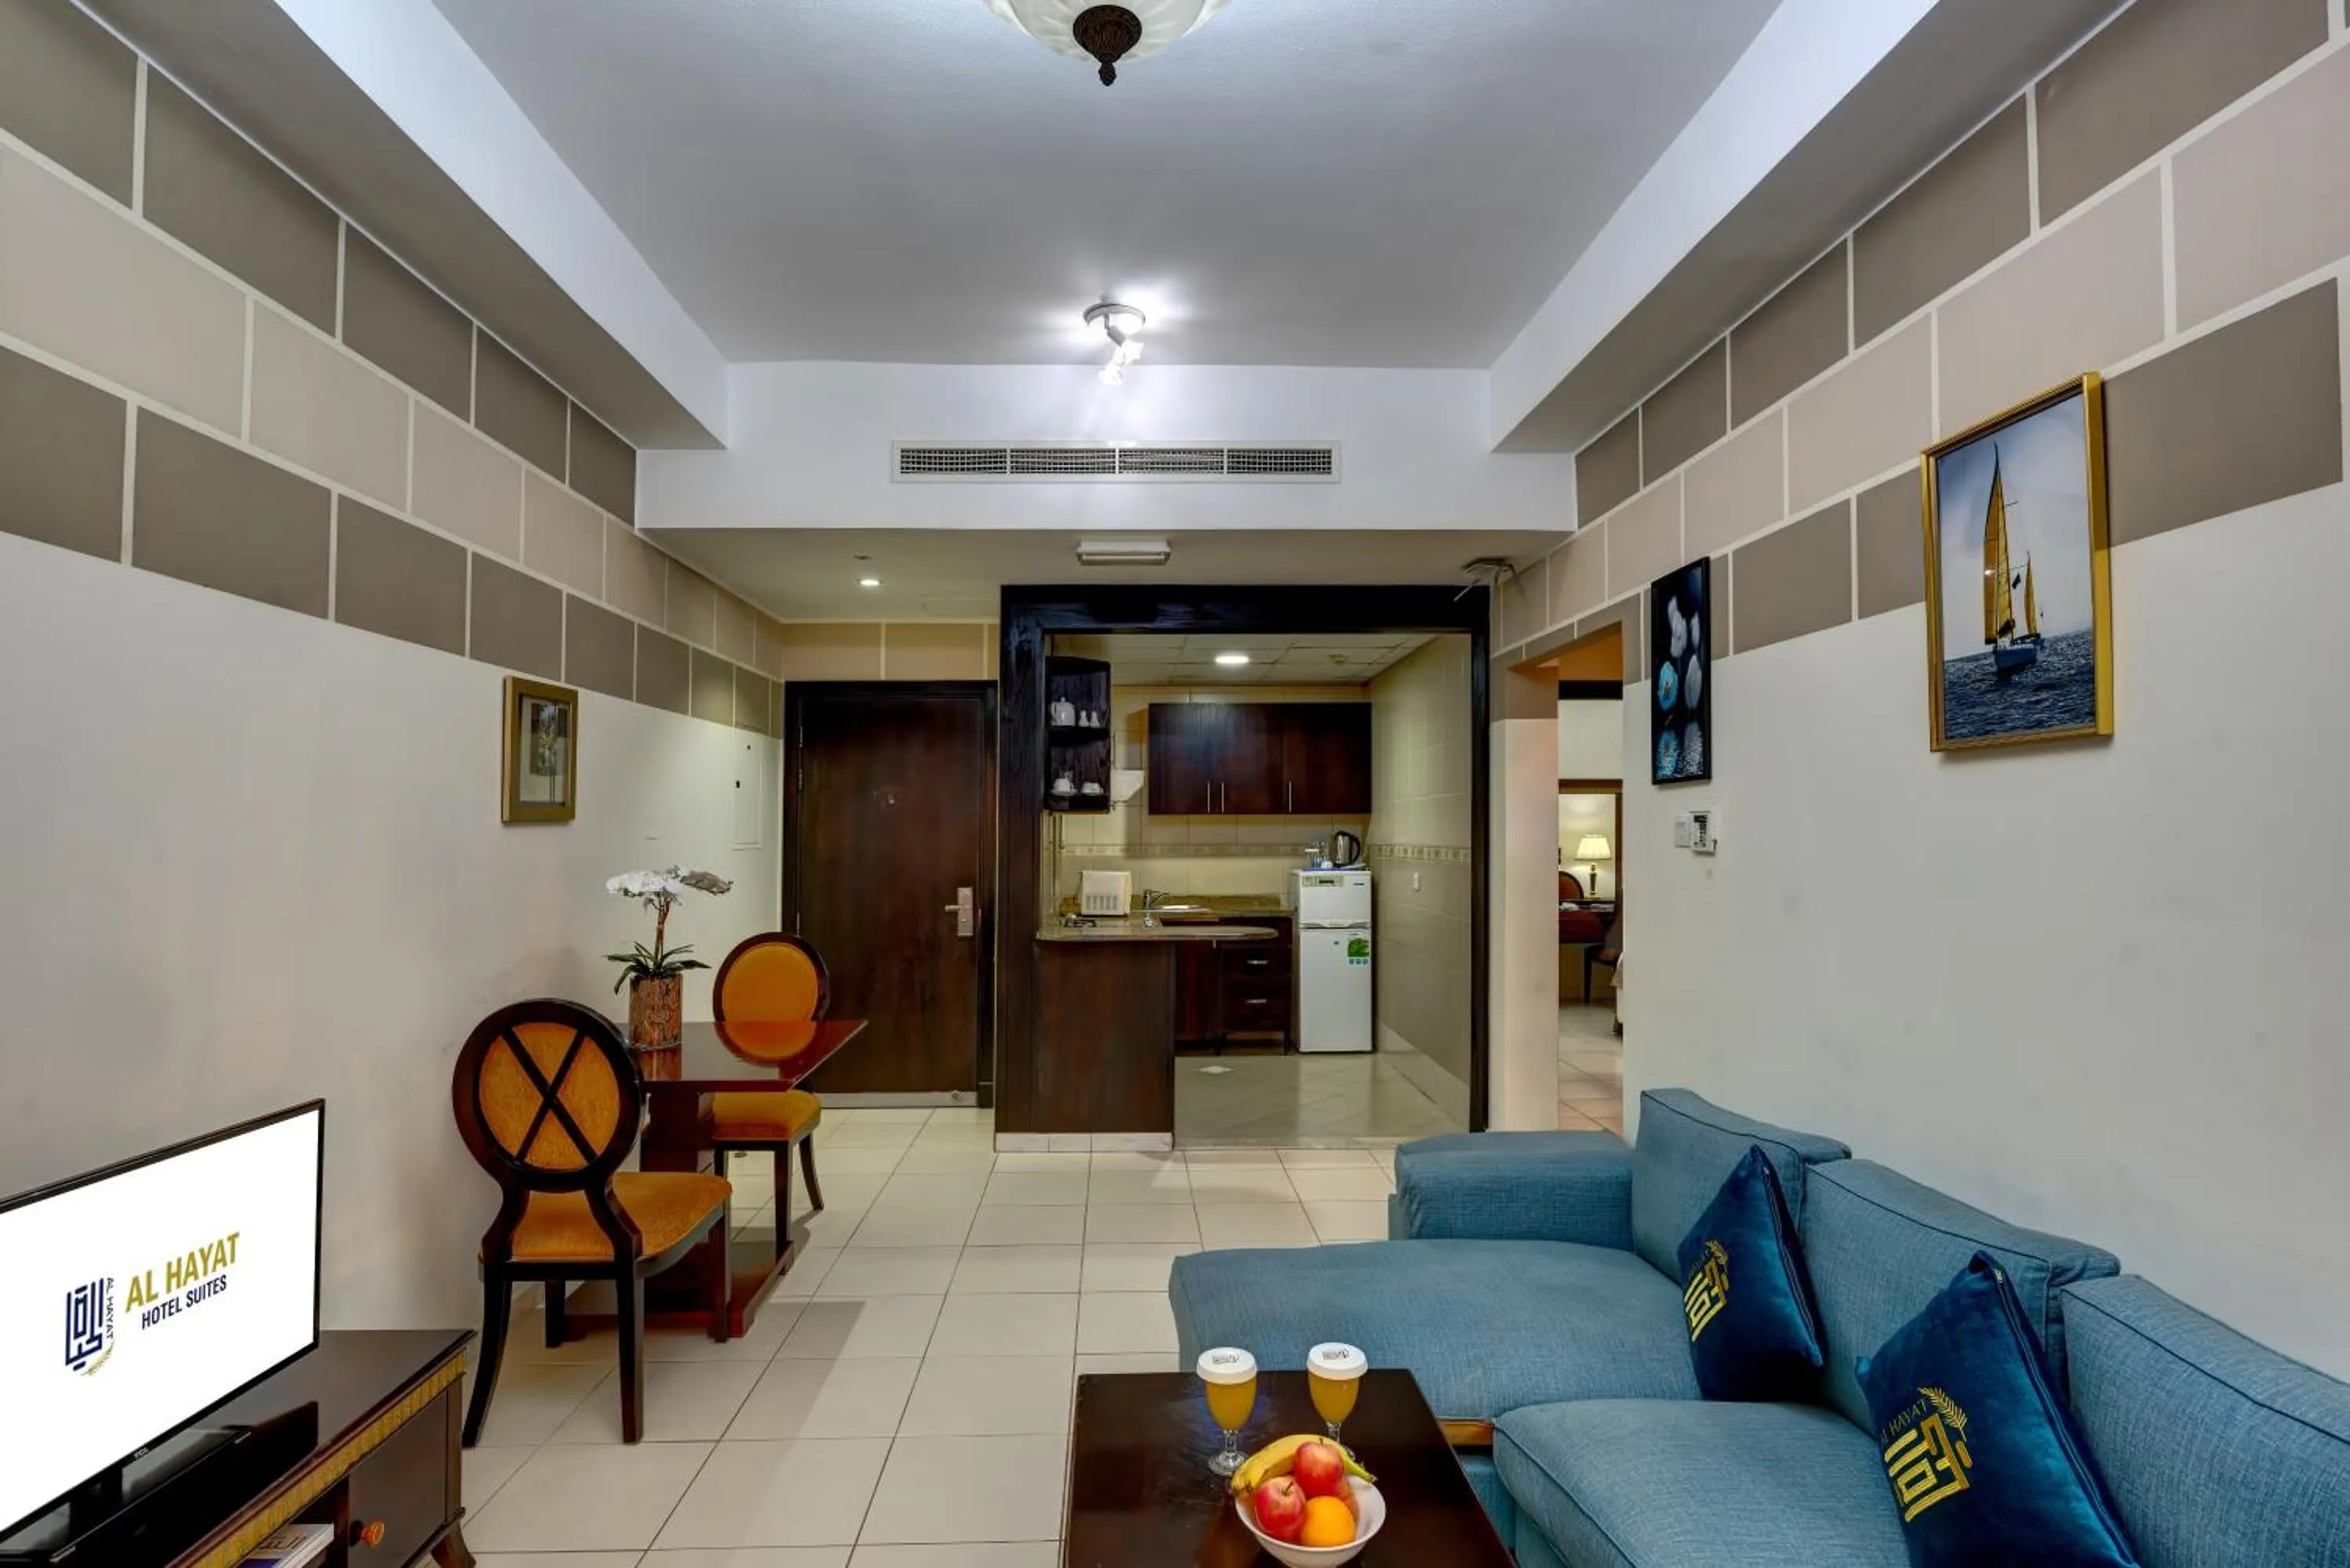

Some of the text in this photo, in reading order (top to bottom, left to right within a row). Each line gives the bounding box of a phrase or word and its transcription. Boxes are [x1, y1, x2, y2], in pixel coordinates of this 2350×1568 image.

[106, 1277, 114, 1295] AL
[125, 1231, 240, 1313] AL HAYAT
[142, 1274, 227, 1330] HOTEL SUITES
